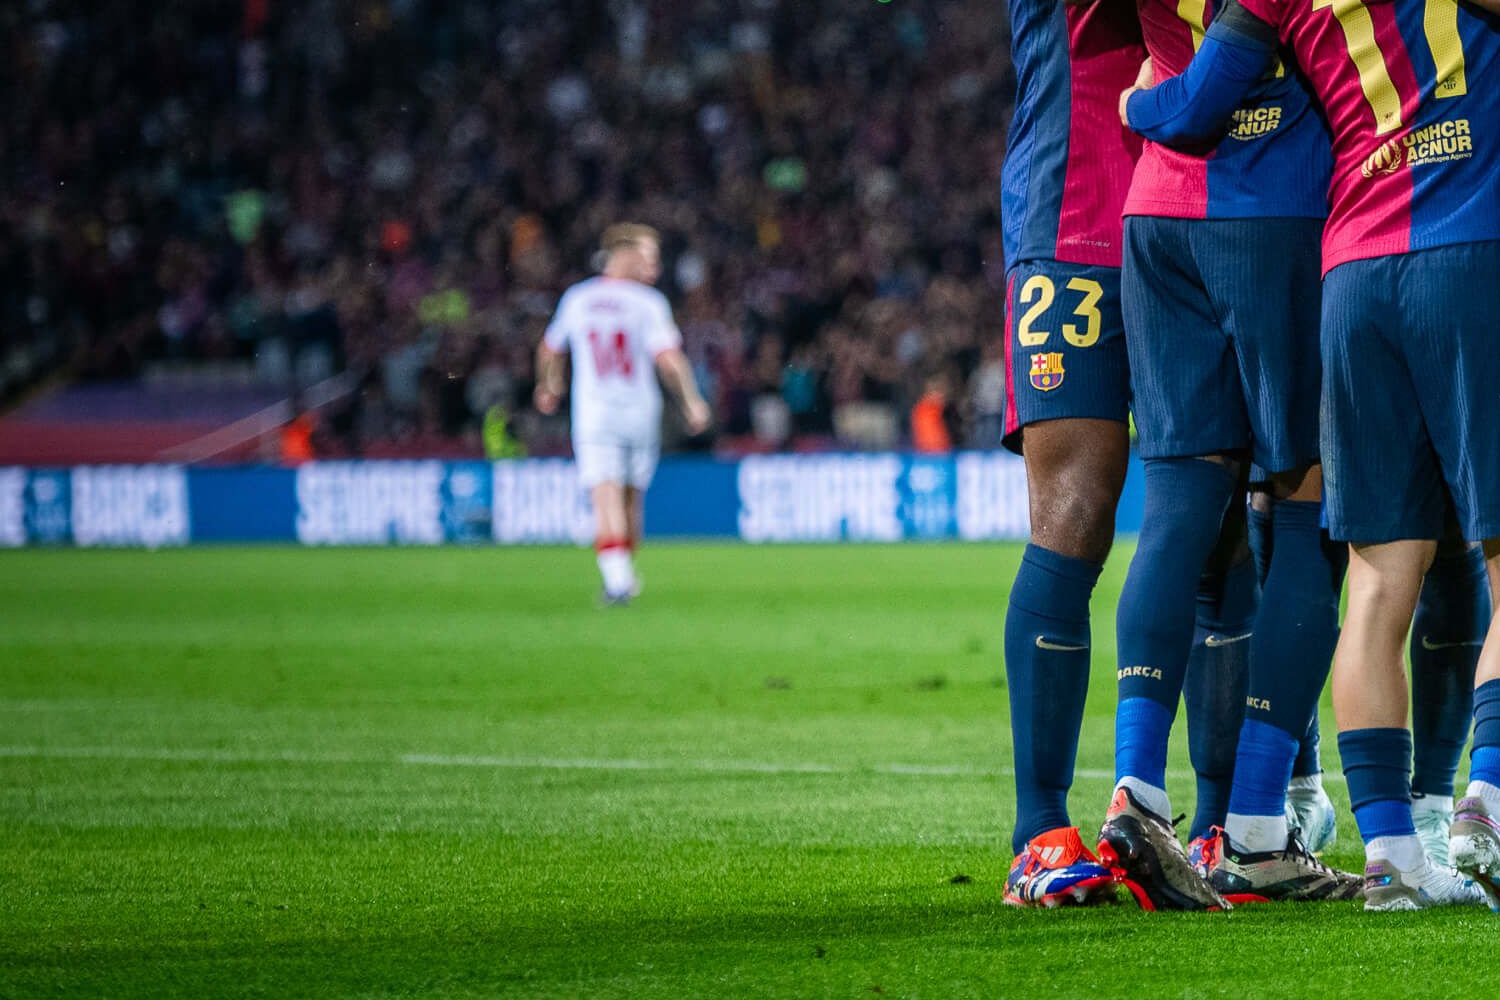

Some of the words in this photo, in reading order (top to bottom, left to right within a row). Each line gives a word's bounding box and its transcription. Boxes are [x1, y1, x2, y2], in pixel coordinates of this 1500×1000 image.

[1402, 119, 1471, 147] UNHCR
[1406, 135, 1473, 161] ACNUR
[1018, 275, 1104, 348] 23
